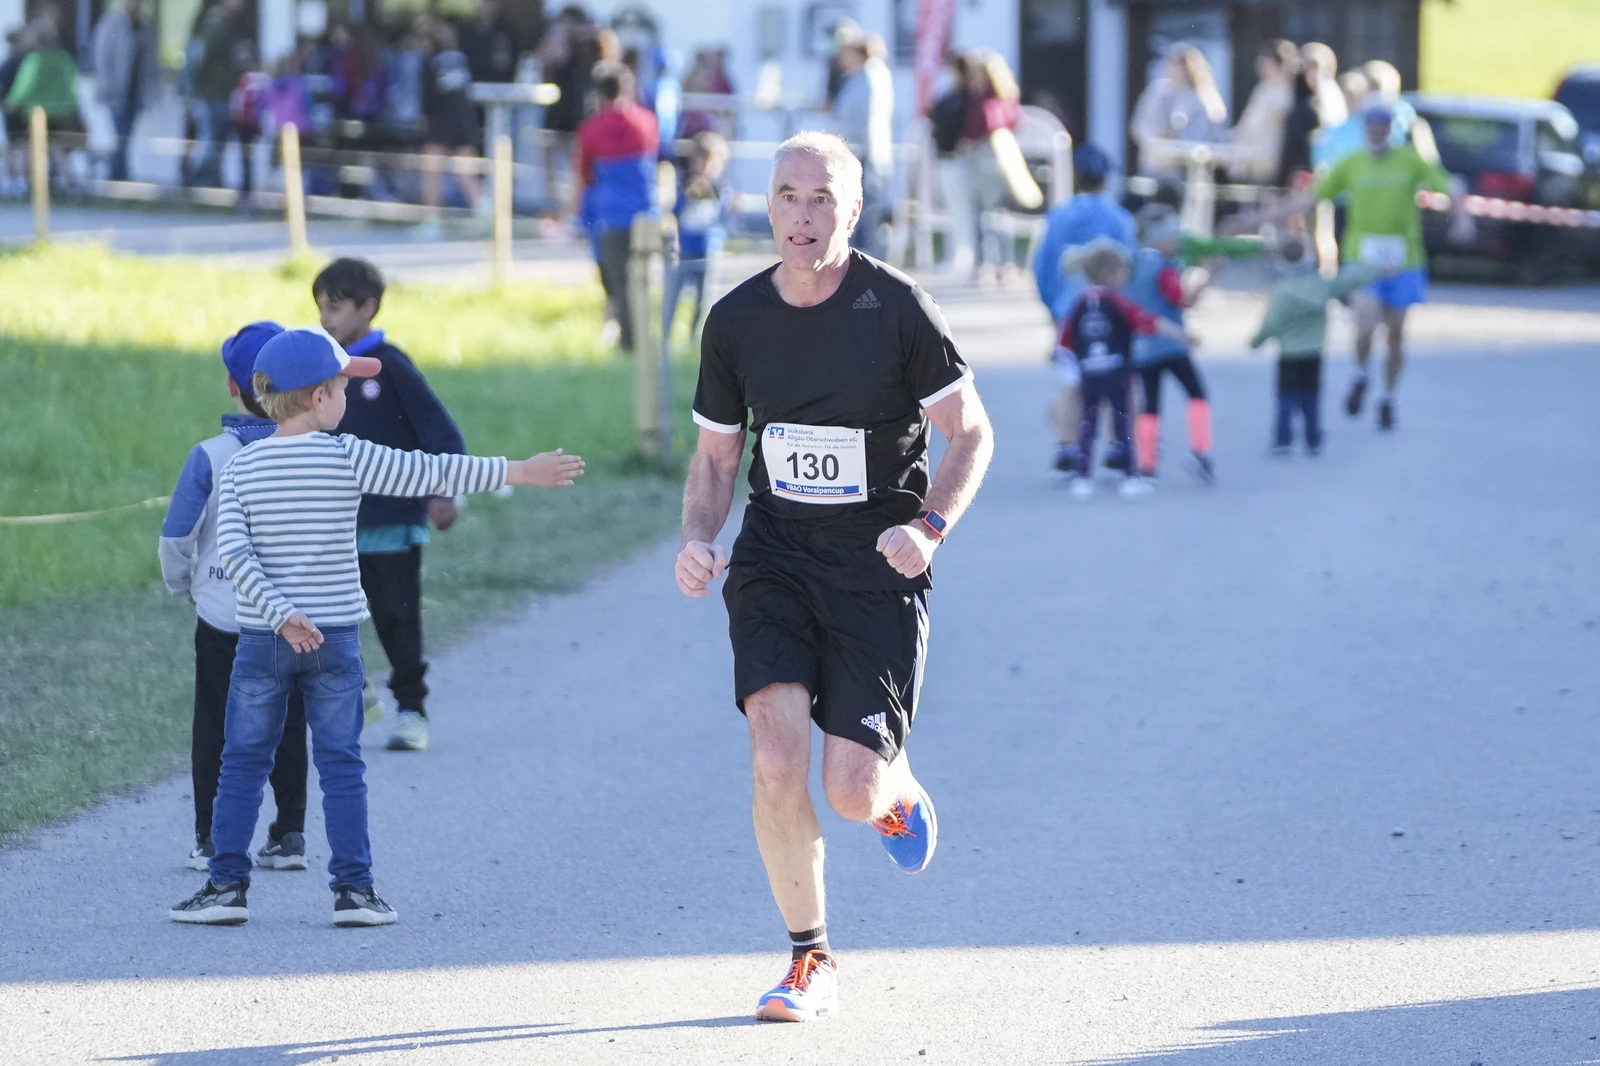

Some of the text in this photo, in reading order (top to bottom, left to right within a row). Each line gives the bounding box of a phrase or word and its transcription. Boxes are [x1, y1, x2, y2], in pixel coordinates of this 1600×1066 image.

[786, 452, 839, 481] 130
[786, 483, 844, 495] VBAO Voralpencup
